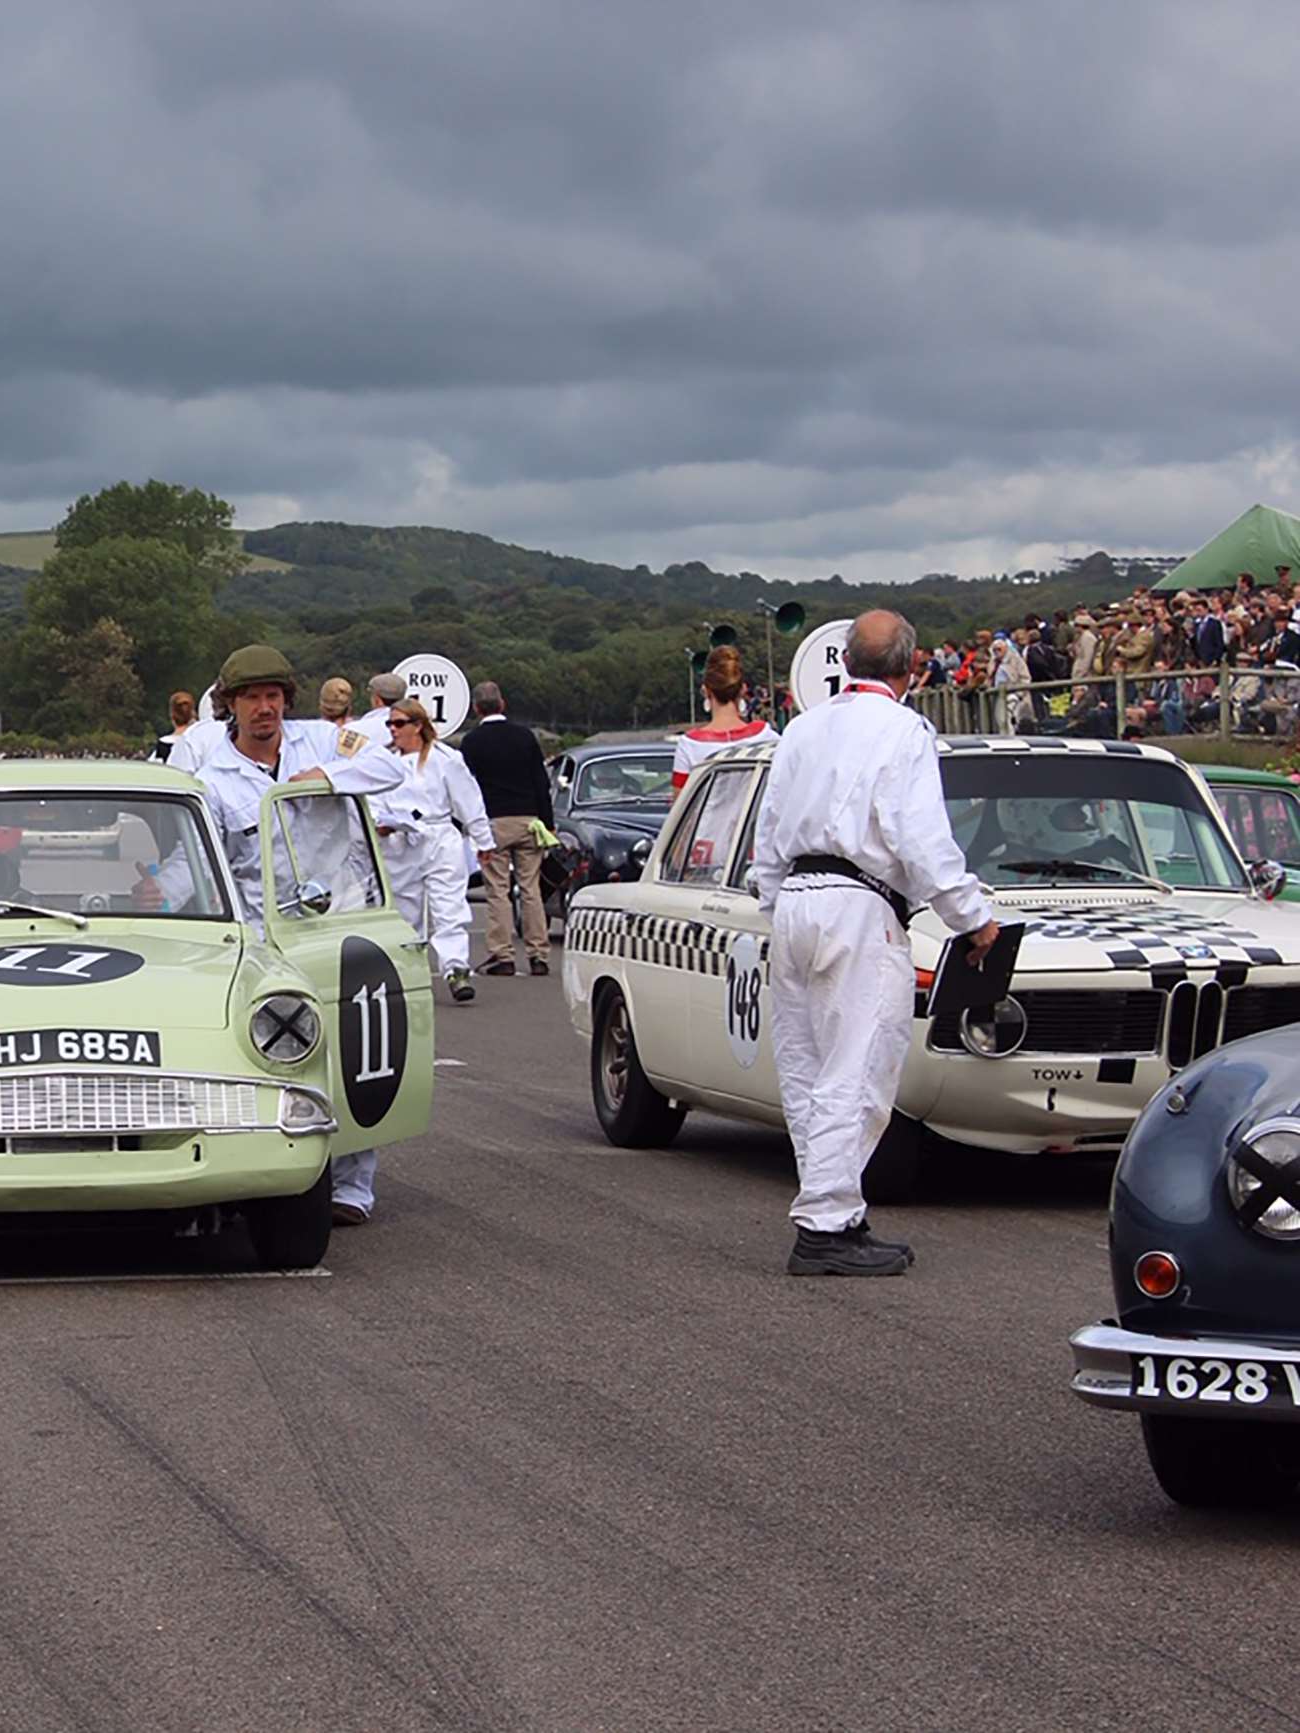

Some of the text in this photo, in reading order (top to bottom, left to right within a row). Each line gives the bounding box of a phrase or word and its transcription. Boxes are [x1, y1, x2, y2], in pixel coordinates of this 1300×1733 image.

[409, 673, 448, 688] ROW
[727, 957, 761, 1042] 148
[58, 1031, 154, 1063] 685A
[352, 982, 394, 1082] 11
[1032, 1069, 1071, 1081] TOW
[1136, 1356, 1269, 1403] 1628
